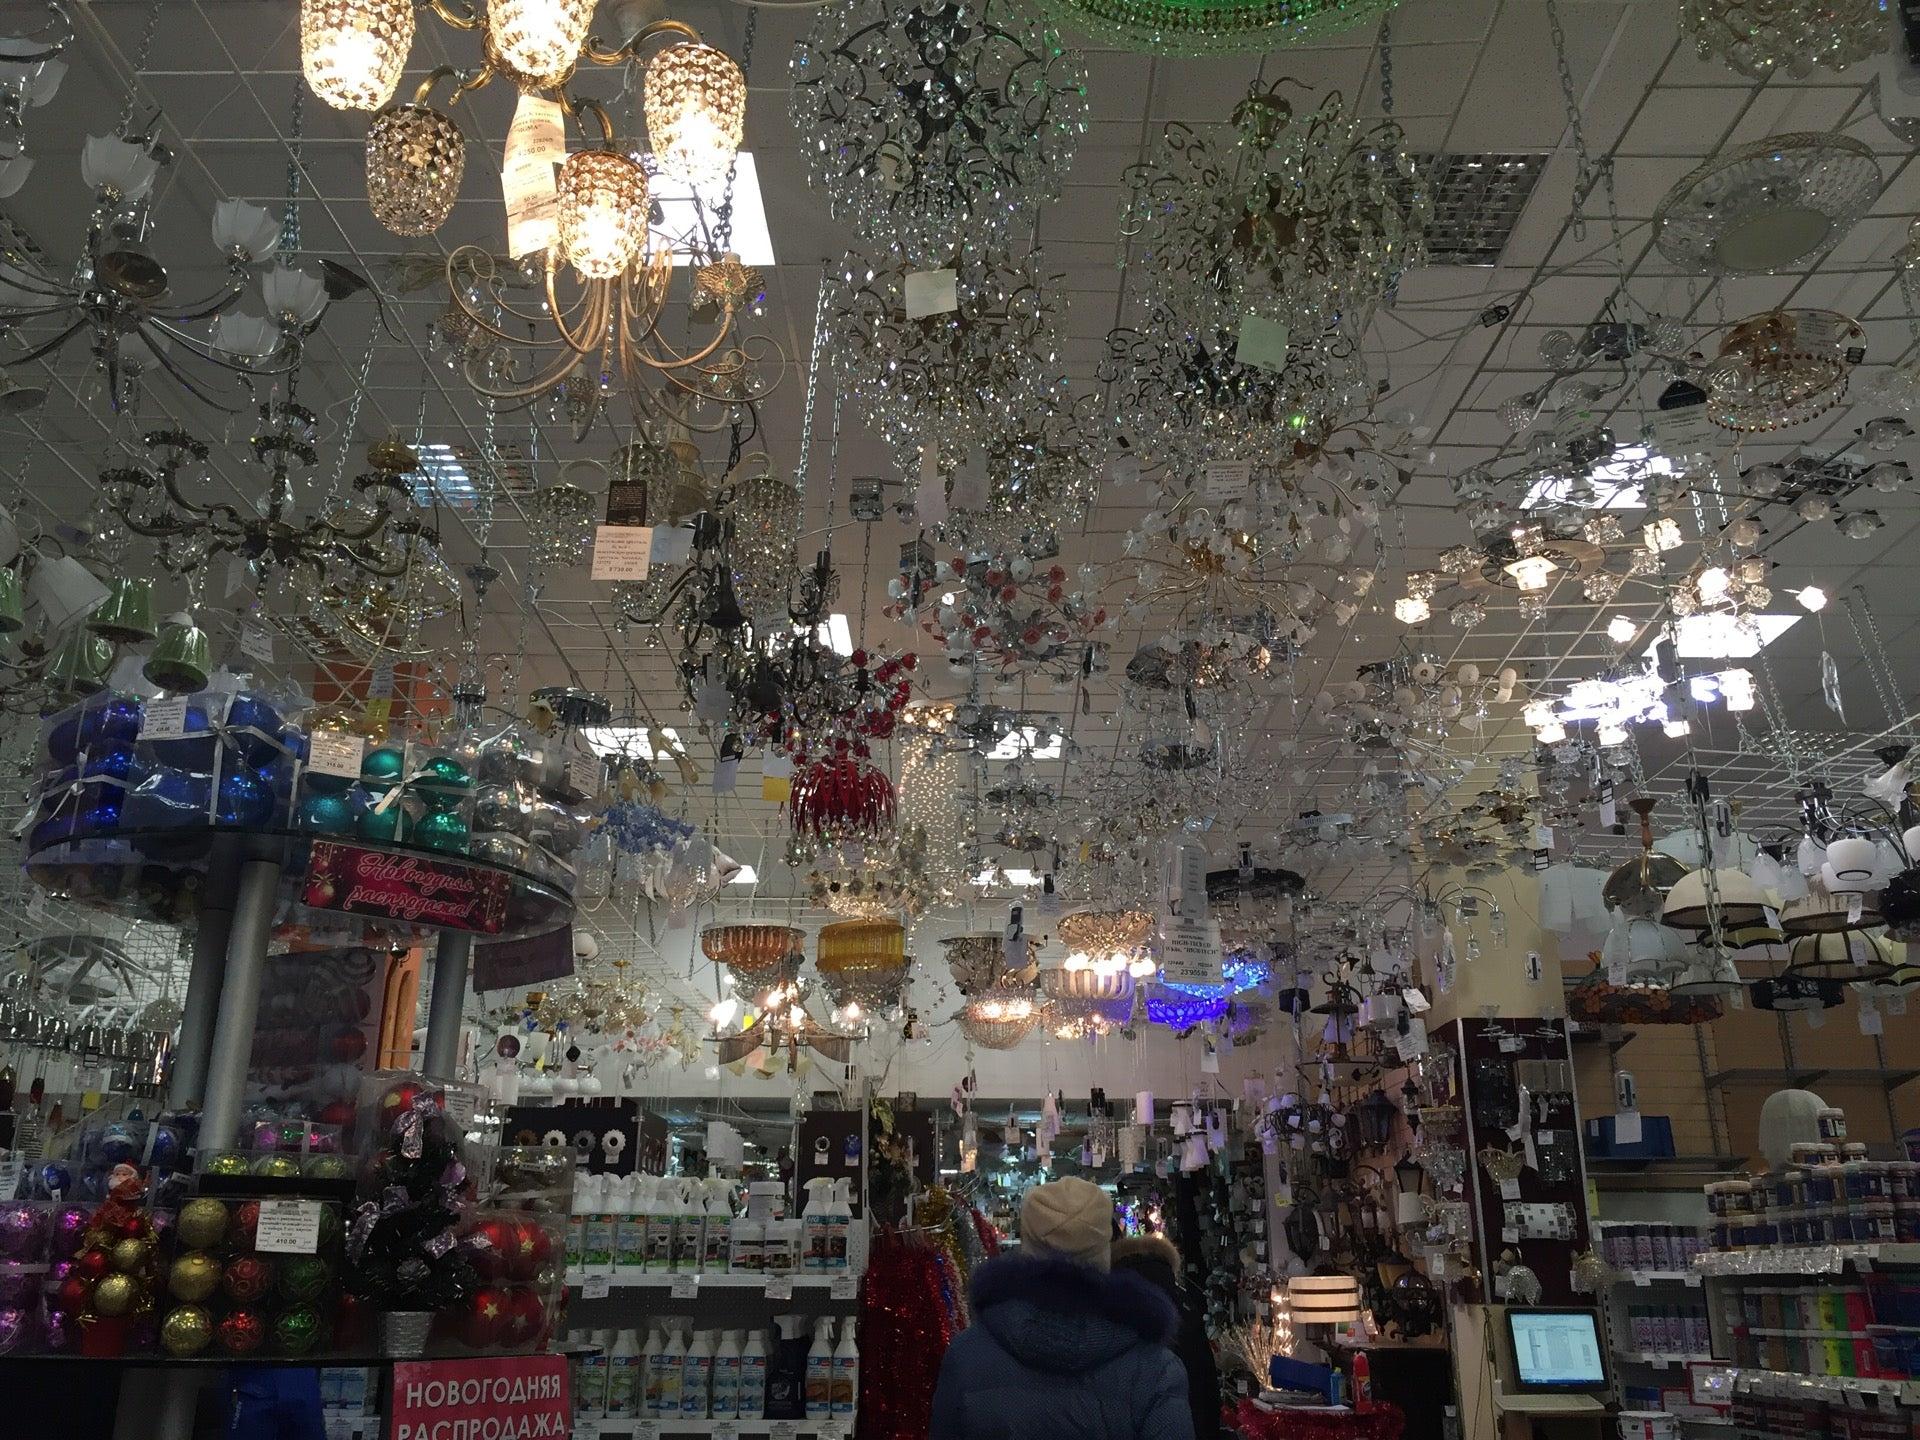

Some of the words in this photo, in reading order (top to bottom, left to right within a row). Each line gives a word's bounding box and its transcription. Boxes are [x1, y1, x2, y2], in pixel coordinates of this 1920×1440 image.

[357, 853, 475, 896] Новогодняя
[343, 886, 479, 920] распродажа!
[406, 1374, 561, 1409] НОВОГОДНЯЯ
[398, 1411, 565, 1440] РАСПРОДАЖА
